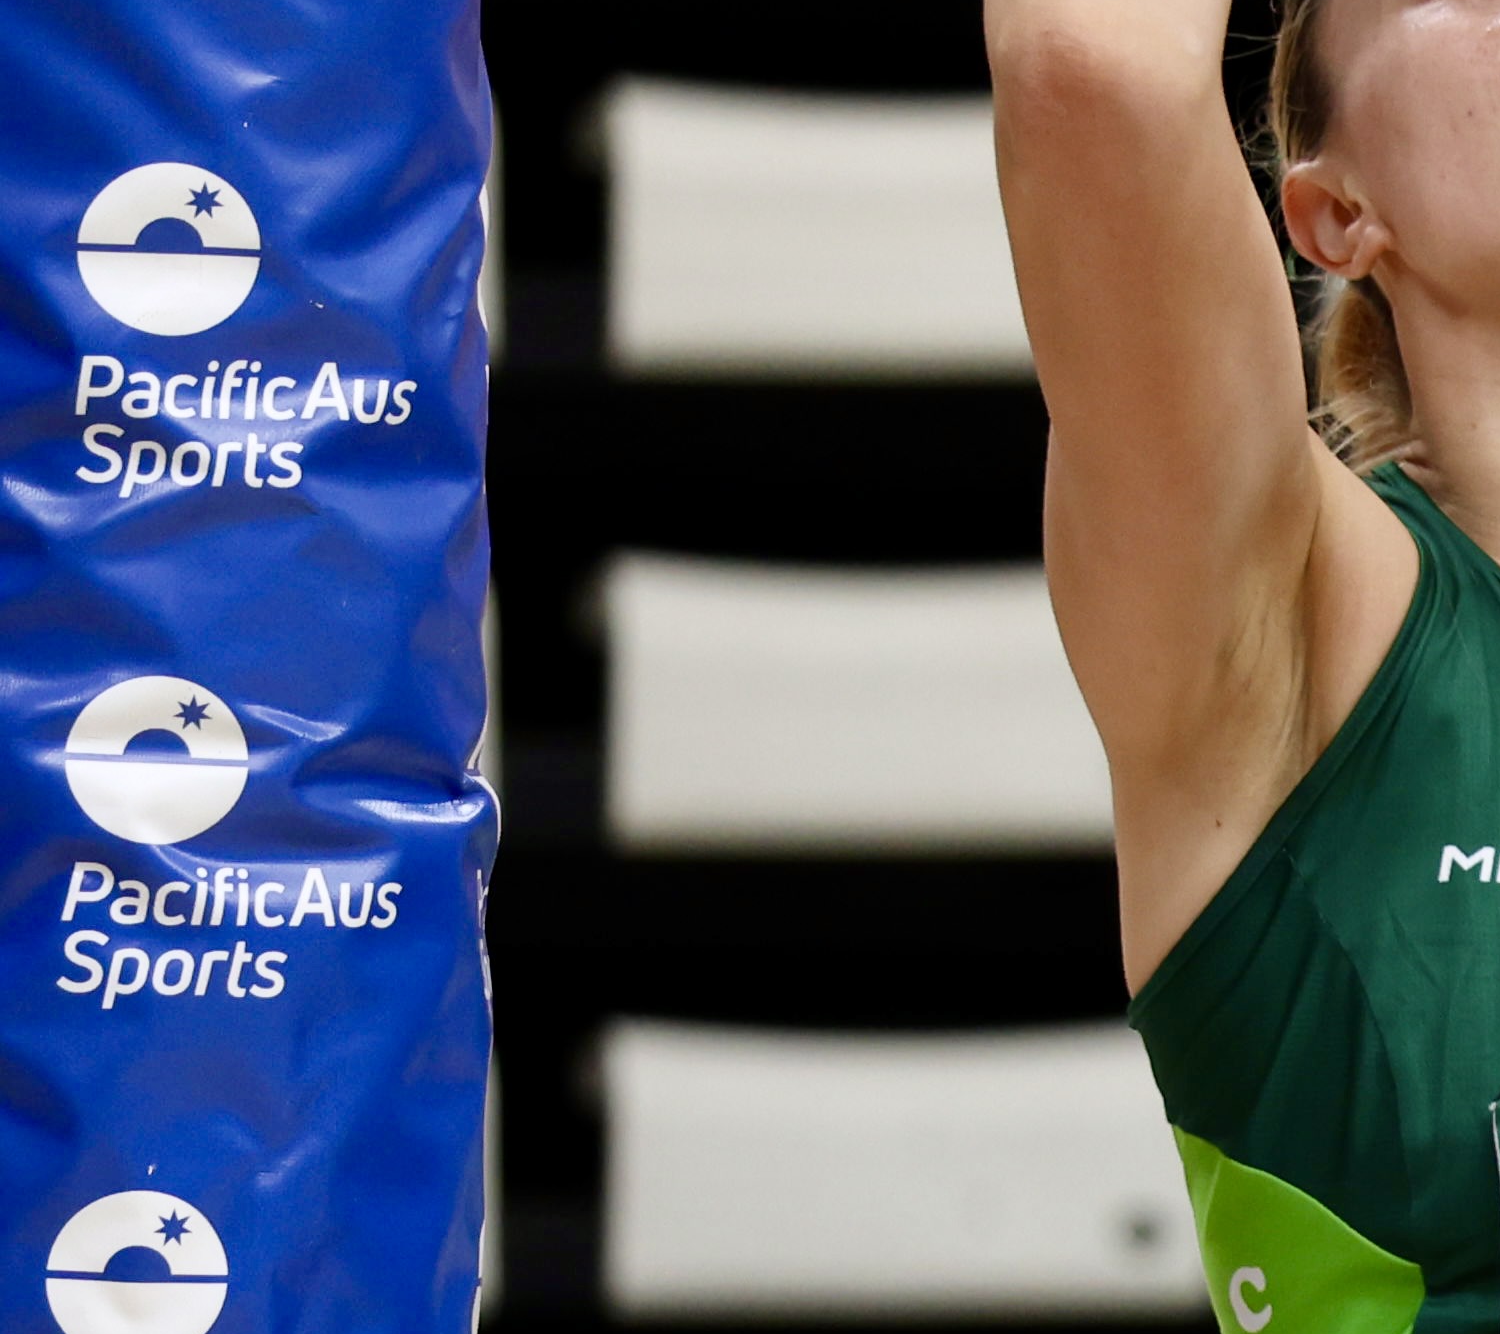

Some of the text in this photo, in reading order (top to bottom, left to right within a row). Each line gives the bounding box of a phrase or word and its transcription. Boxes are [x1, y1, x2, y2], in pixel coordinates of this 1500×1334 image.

[76, 355, 417, 425] PacificAus
[76, 423, 304, 499] Sports
[61, 861, 402, 928] PacificAus
[57, 930, 288, 1009] Sports
